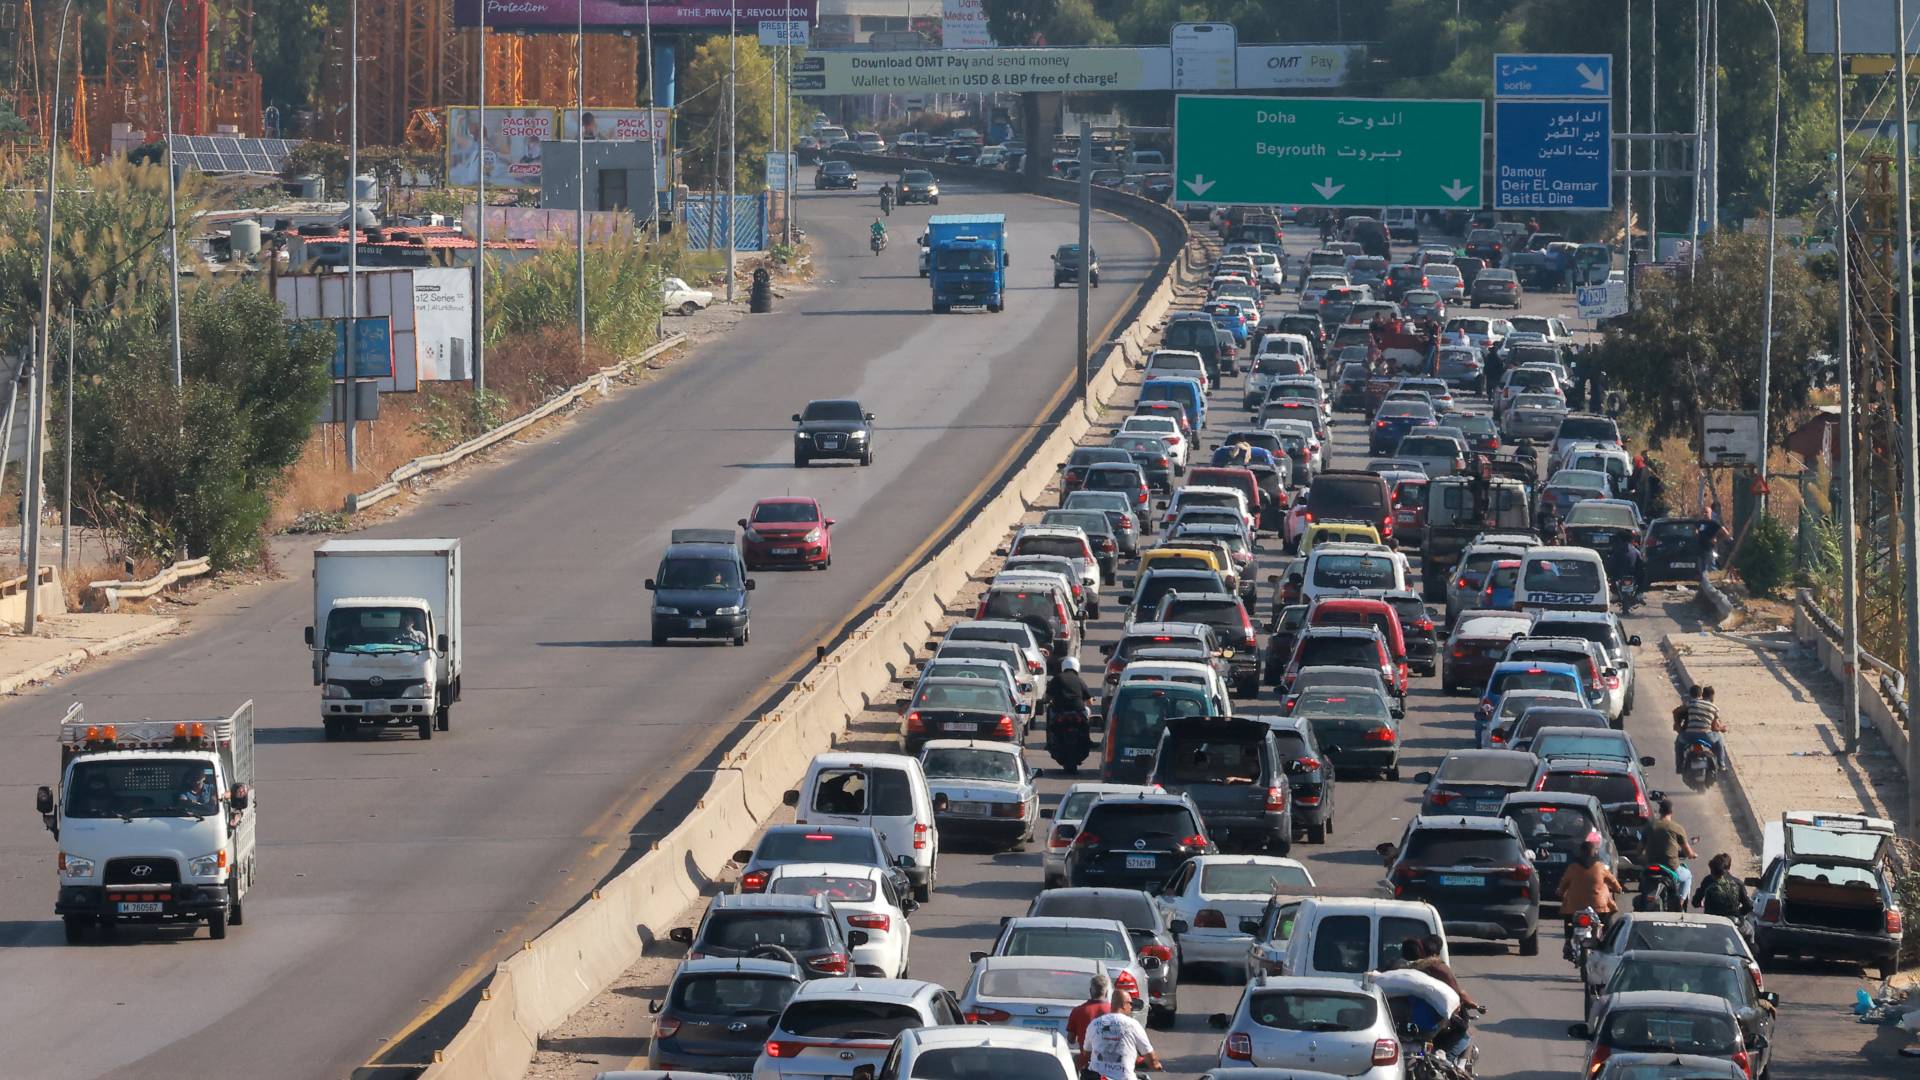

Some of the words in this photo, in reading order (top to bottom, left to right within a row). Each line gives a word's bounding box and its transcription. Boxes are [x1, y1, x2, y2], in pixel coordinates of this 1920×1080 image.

[677, 8, 808, 18] #THE_PRIVAE_REVOLUTION
[761, 22, 799, 30] PRESTGE
[852, 56, 912, 69] Download
[915, 56, 944, 68] OMT
[947, 56, 969, 69] Pay
[972, 55, 994, 66] and
[997, 55, 1026, 66] send
[1029, 56, 1070, 69] money
[1267, 56, 1302, 69] OMT
[1310, 56, 1334, 71] Pay
[852, 75, 889, 87] Wallet
[893, 75, 905, 87] to
[908, 74, 946, 86] Wallet
[949, 75, 960, 86] in
[963, 74, 988, 86] USD
[991, 74, 1001, 85] &
[1004, 73, 1028, 85] LBP
[1031, 73, 1055, 85] free
[1057, 72, 1070, 84] of
[1073, 72, 1118, 87] charge!
[1503, 80, 1532, 90] sortie
[503, 118, 533, 126] PACK
[535, 118, 549, 126] TO
[617, 119, 645, 128] PACK
[647, 119, 663, 128] O
[1256, 111, 1296, 124] Doha
[1337, 111, 1402, 129] الدوحة
[1549, 111, 1601, 126] الدامور
[503, 128, 549, 136] SCHOOL
[617, 129, 663, 138] SCHOL
[1544, 127, 1579, 141] القمر
[1583, 130, 1601, 142] دير
[1256, 142, 1326, 157] Beyrouth
[1337, 144, 1403, 161] بيروت
[1538, 145, 1572, 158] الدين
[1575, 146, 1600, 160] بيت
[1502, 165, 1546, 177] Damour
[1502, 180, 1530, 191] Deir
[1533, 179, 1549, 190] EL
[1552, 180, 1598, 191] Qamar
[1502, 193, 1530, 205] Beit
[1531, 193, 1545, 204] EL
[1548, 193, 1573, 204] Dine
[431, 293, 456, 302] Series
